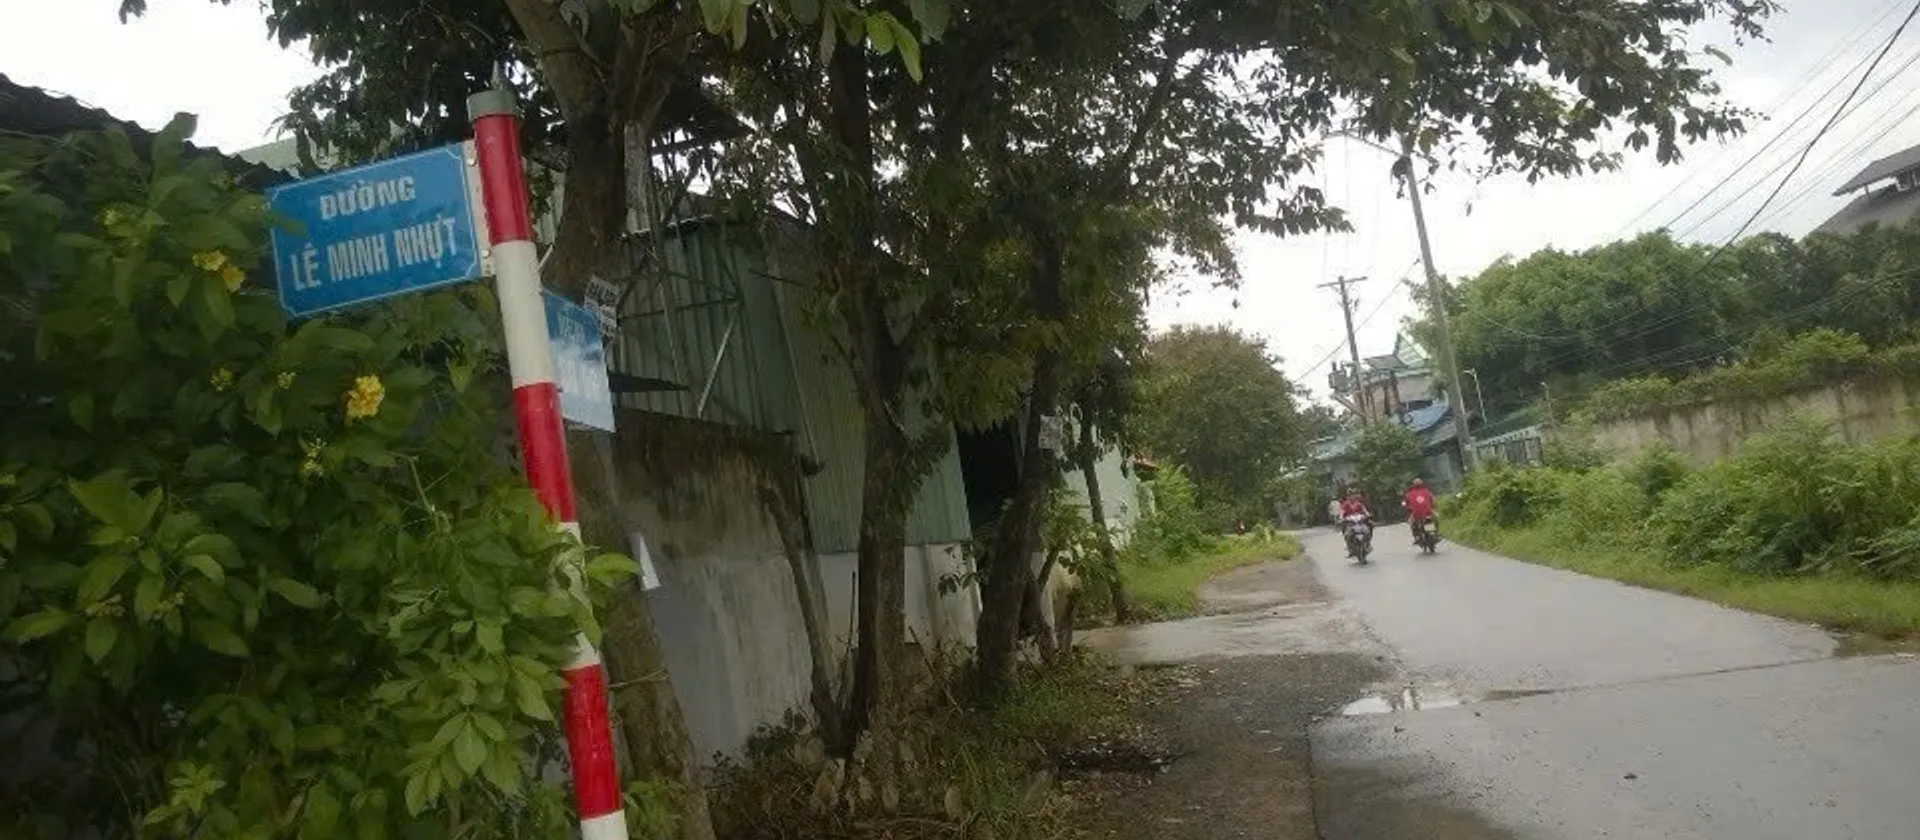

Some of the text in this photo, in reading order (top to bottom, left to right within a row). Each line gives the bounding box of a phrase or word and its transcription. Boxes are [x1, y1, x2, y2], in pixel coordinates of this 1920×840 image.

[320, 176, 416, 220] ĐƯỜNG
[290, 214, 456, 291] LÊ MINH NHỰT
